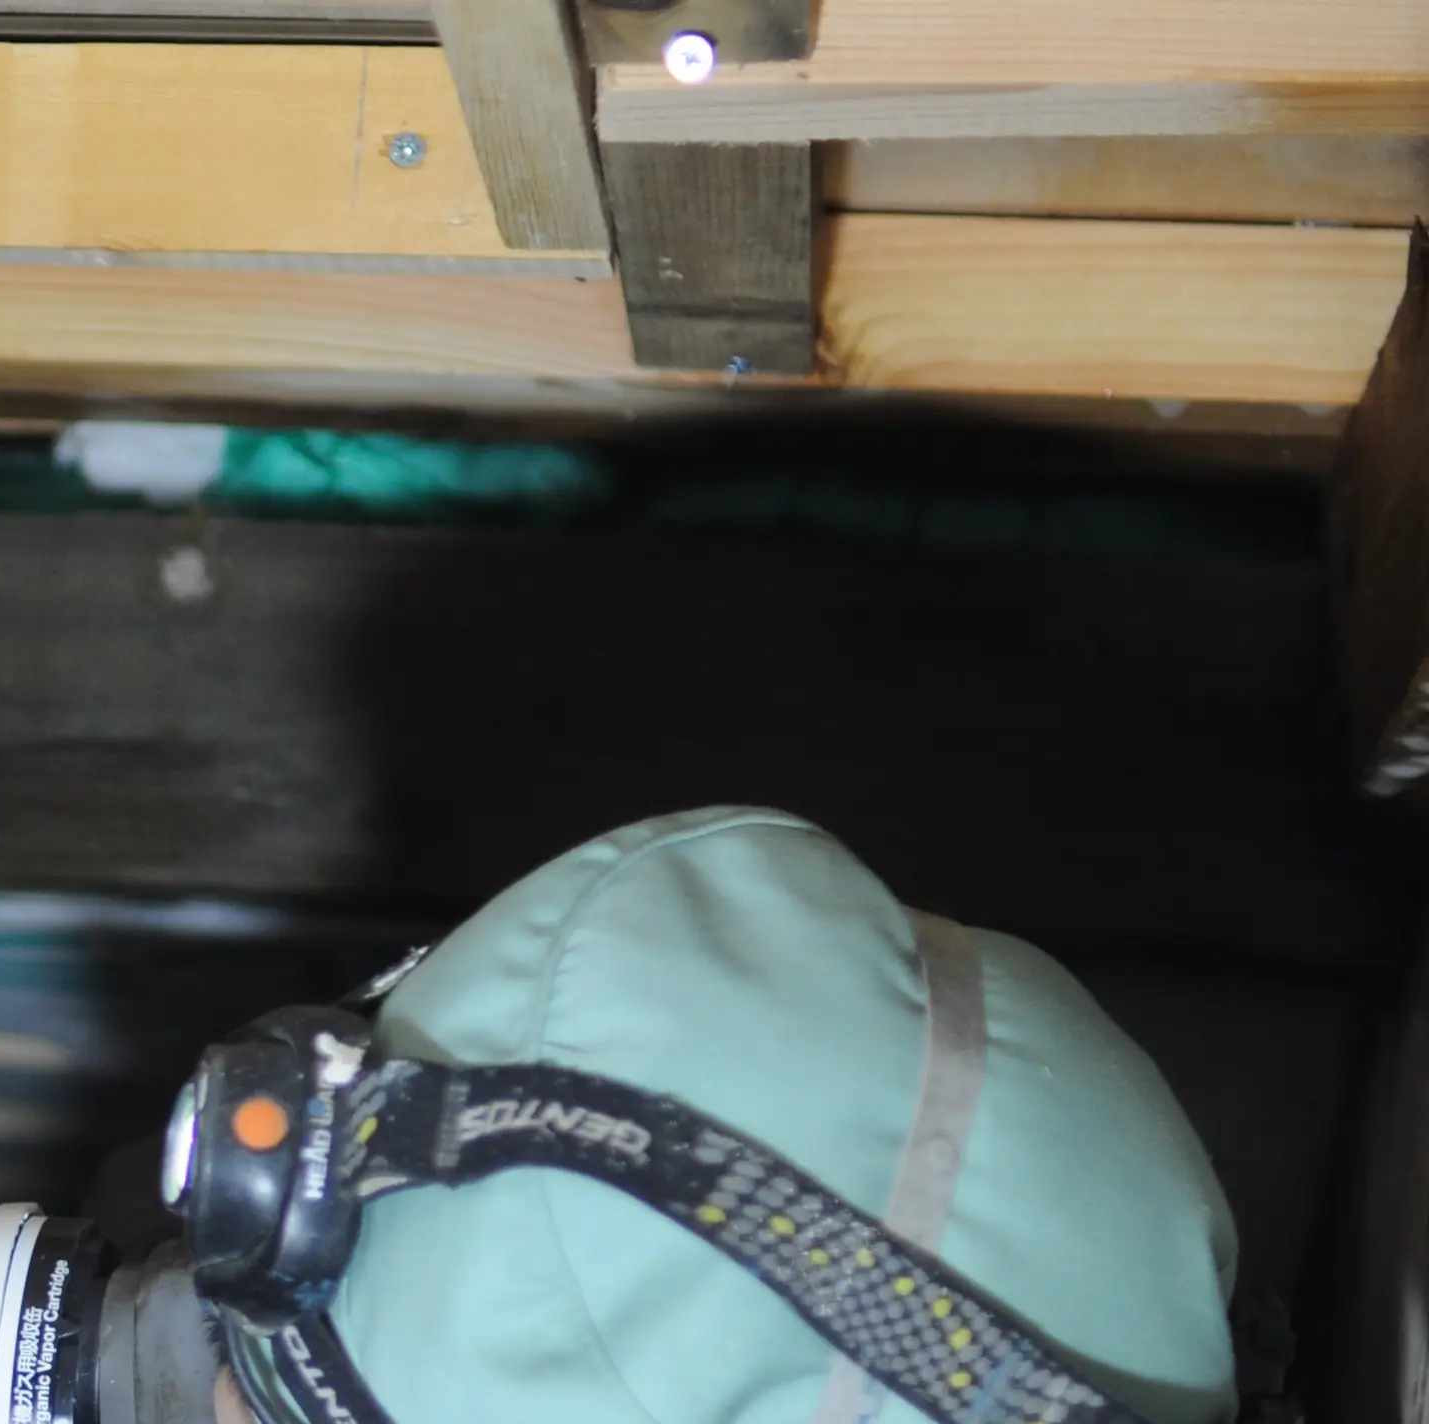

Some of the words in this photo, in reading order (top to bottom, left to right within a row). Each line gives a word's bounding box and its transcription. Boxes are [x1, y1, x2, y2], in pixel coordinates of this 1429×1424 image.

[459, 1099, 652, 1154] GENTOS
[299, 1129, 332, 1198] HEAD
[43, 1259, 70, 1322] Cartridge
[36, 1323, 58, 1374] Vapor
